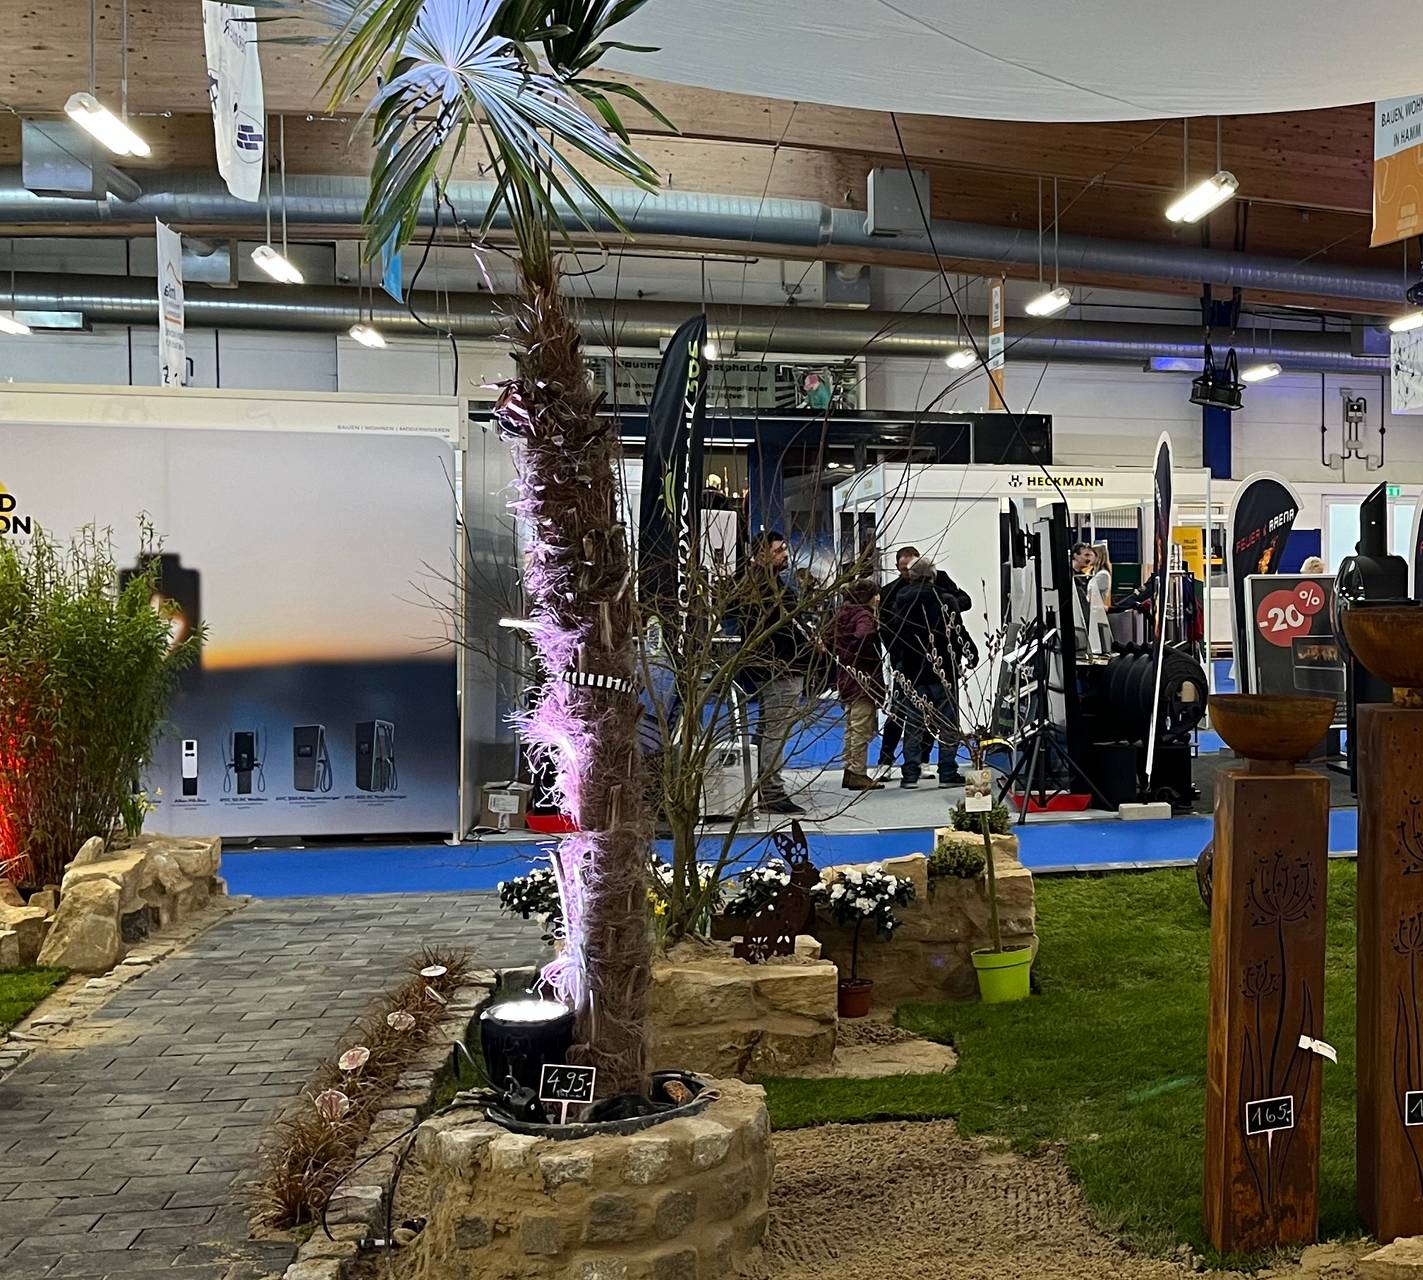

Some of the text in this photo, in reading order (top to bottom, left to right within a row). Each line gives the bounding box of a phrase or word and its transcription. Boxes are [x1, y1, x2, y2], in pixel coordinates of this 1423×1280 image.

[1400, 123, 1422, 143] HAMM
[1027, 476, 1104, 487] HECKMANN
[1235, 530, 1262, 554] FEUER
[1258, 604, 1305, 632] -20
